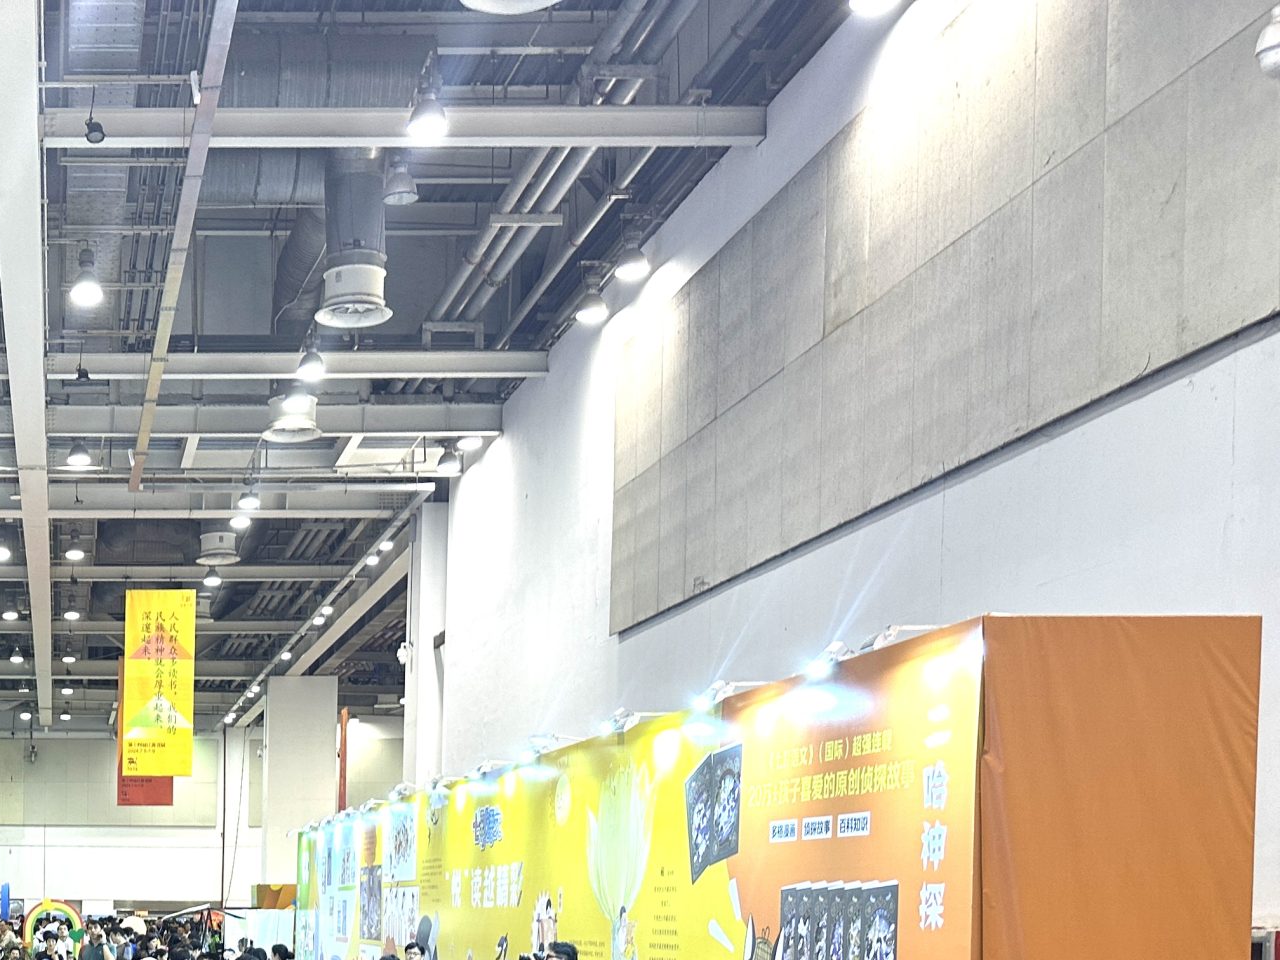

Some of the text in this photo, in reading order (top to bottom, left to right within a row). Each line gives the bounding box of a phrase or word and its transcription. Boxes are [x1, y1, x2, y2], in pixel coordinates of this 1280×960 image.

[803, 819, 832, 838] 侦探故事
[839, 816, 869, 835] 百科知识
